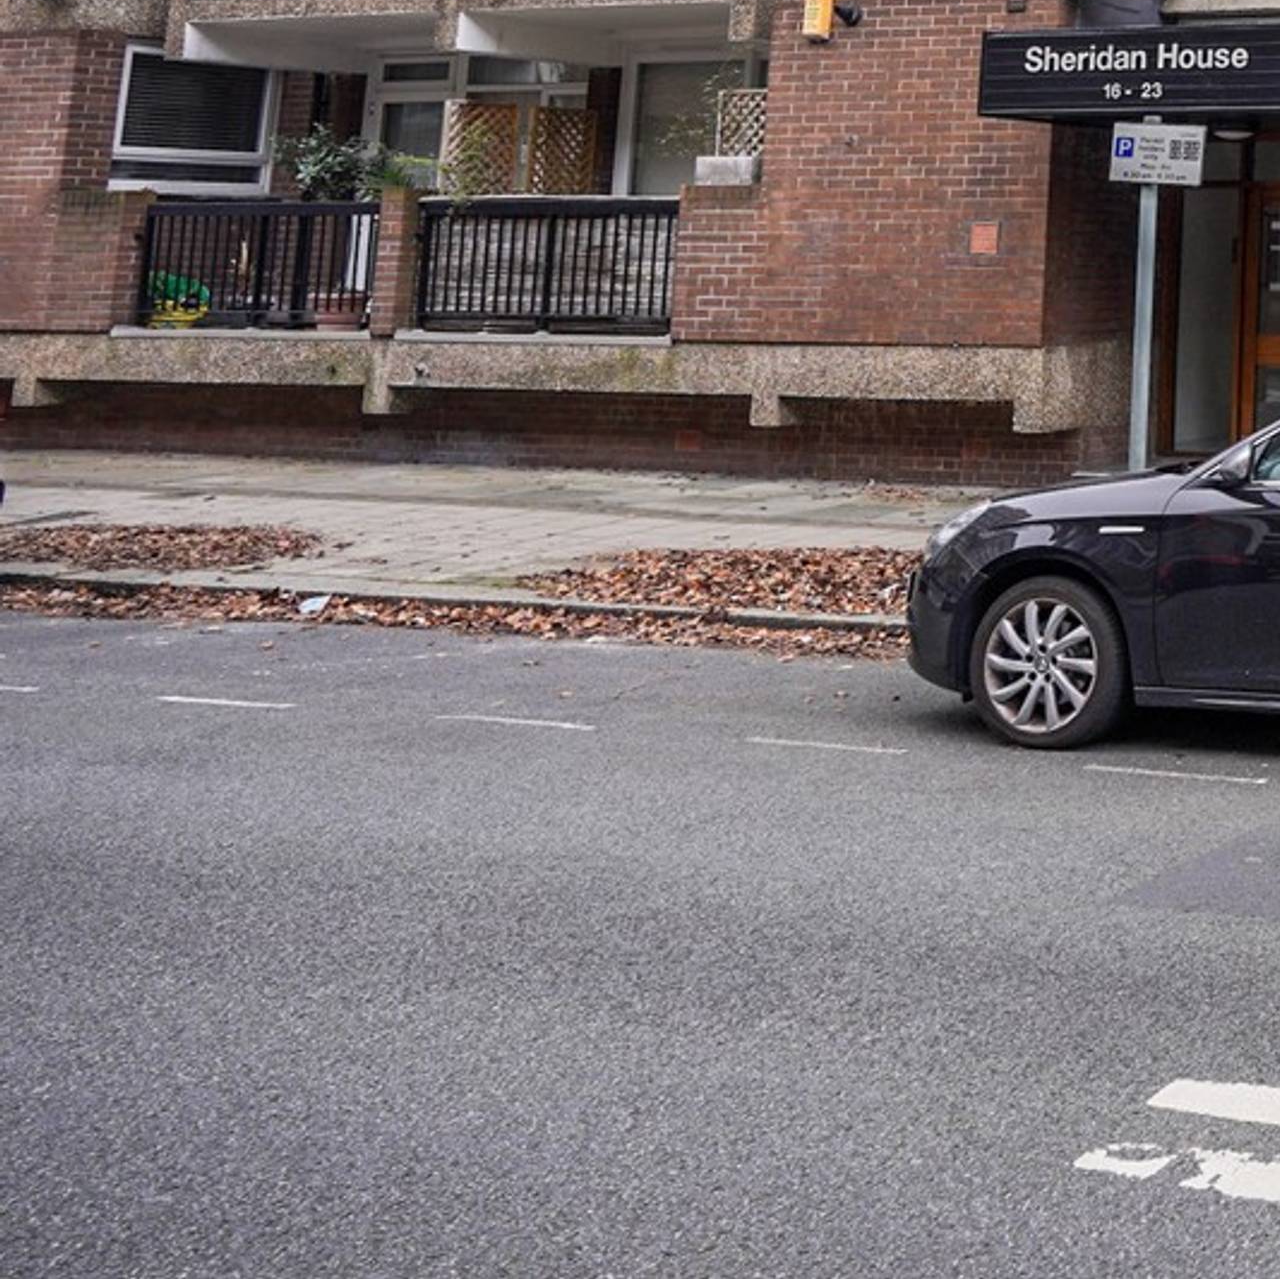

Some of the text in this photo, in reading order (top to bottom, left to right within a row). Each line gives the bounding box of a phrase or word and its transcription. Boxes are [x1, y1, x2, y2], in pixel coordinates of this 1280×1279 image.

[1024, 43, 1249, 72] Sheridan House
[1140, 82, 1163, 99] 23
[1119, 139, 1132, 156] P
